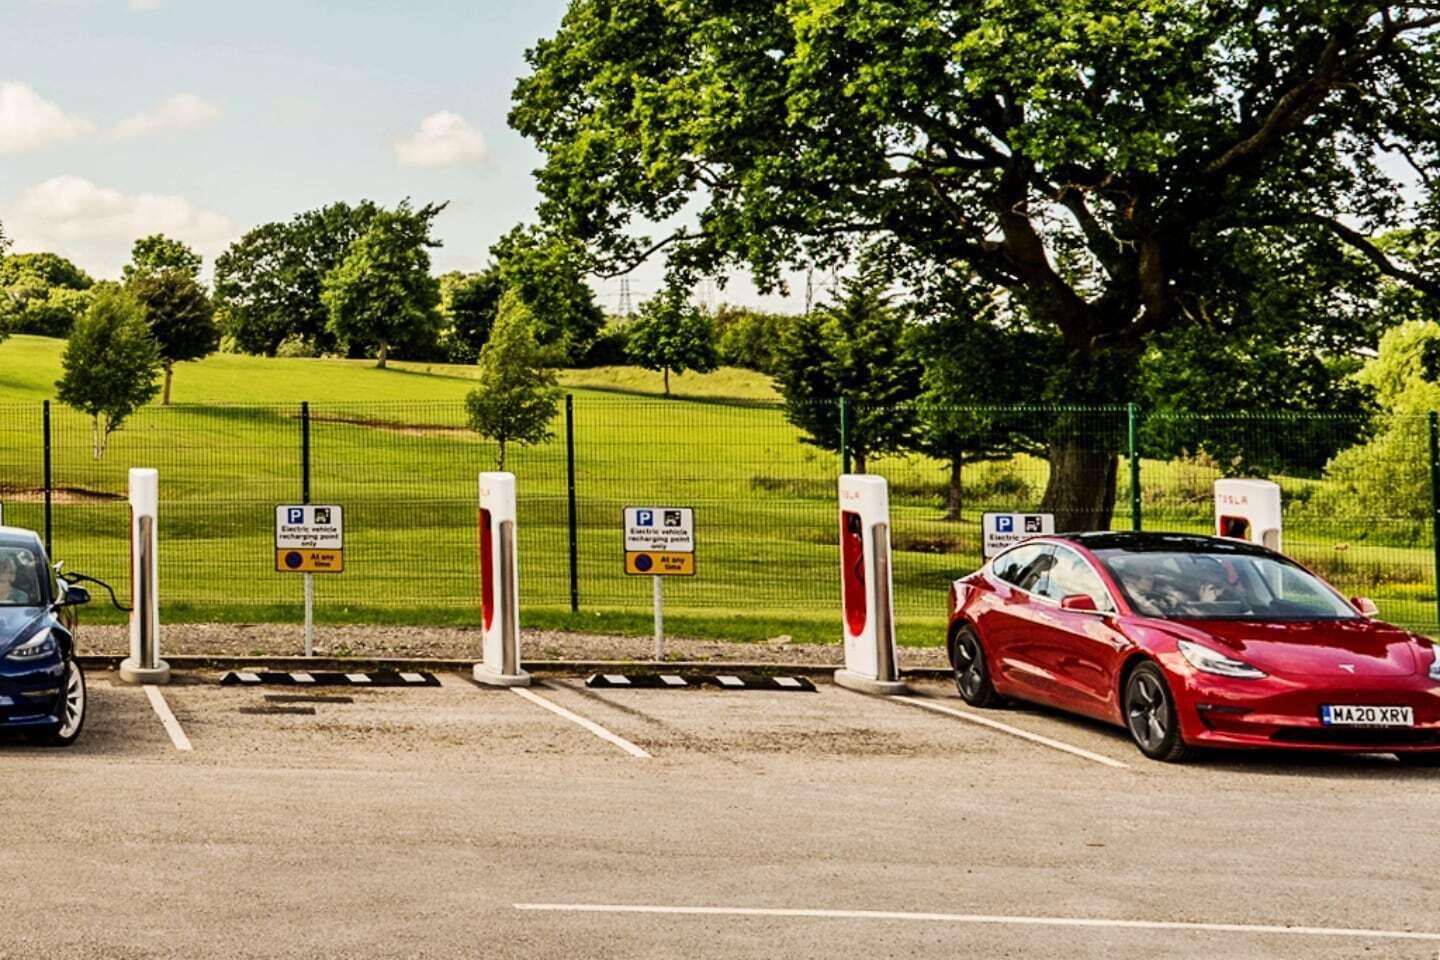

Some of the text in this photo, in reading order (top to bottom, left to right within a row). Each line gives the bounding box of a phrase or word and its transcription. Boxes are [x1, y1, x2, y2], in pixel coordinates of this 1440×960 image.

[291, 509, 301, 523] P
[640, 512, 650, 525] P
[999, 518, 1011, 531] P
[1334, 708, 1408, 722] MA20 XRV
